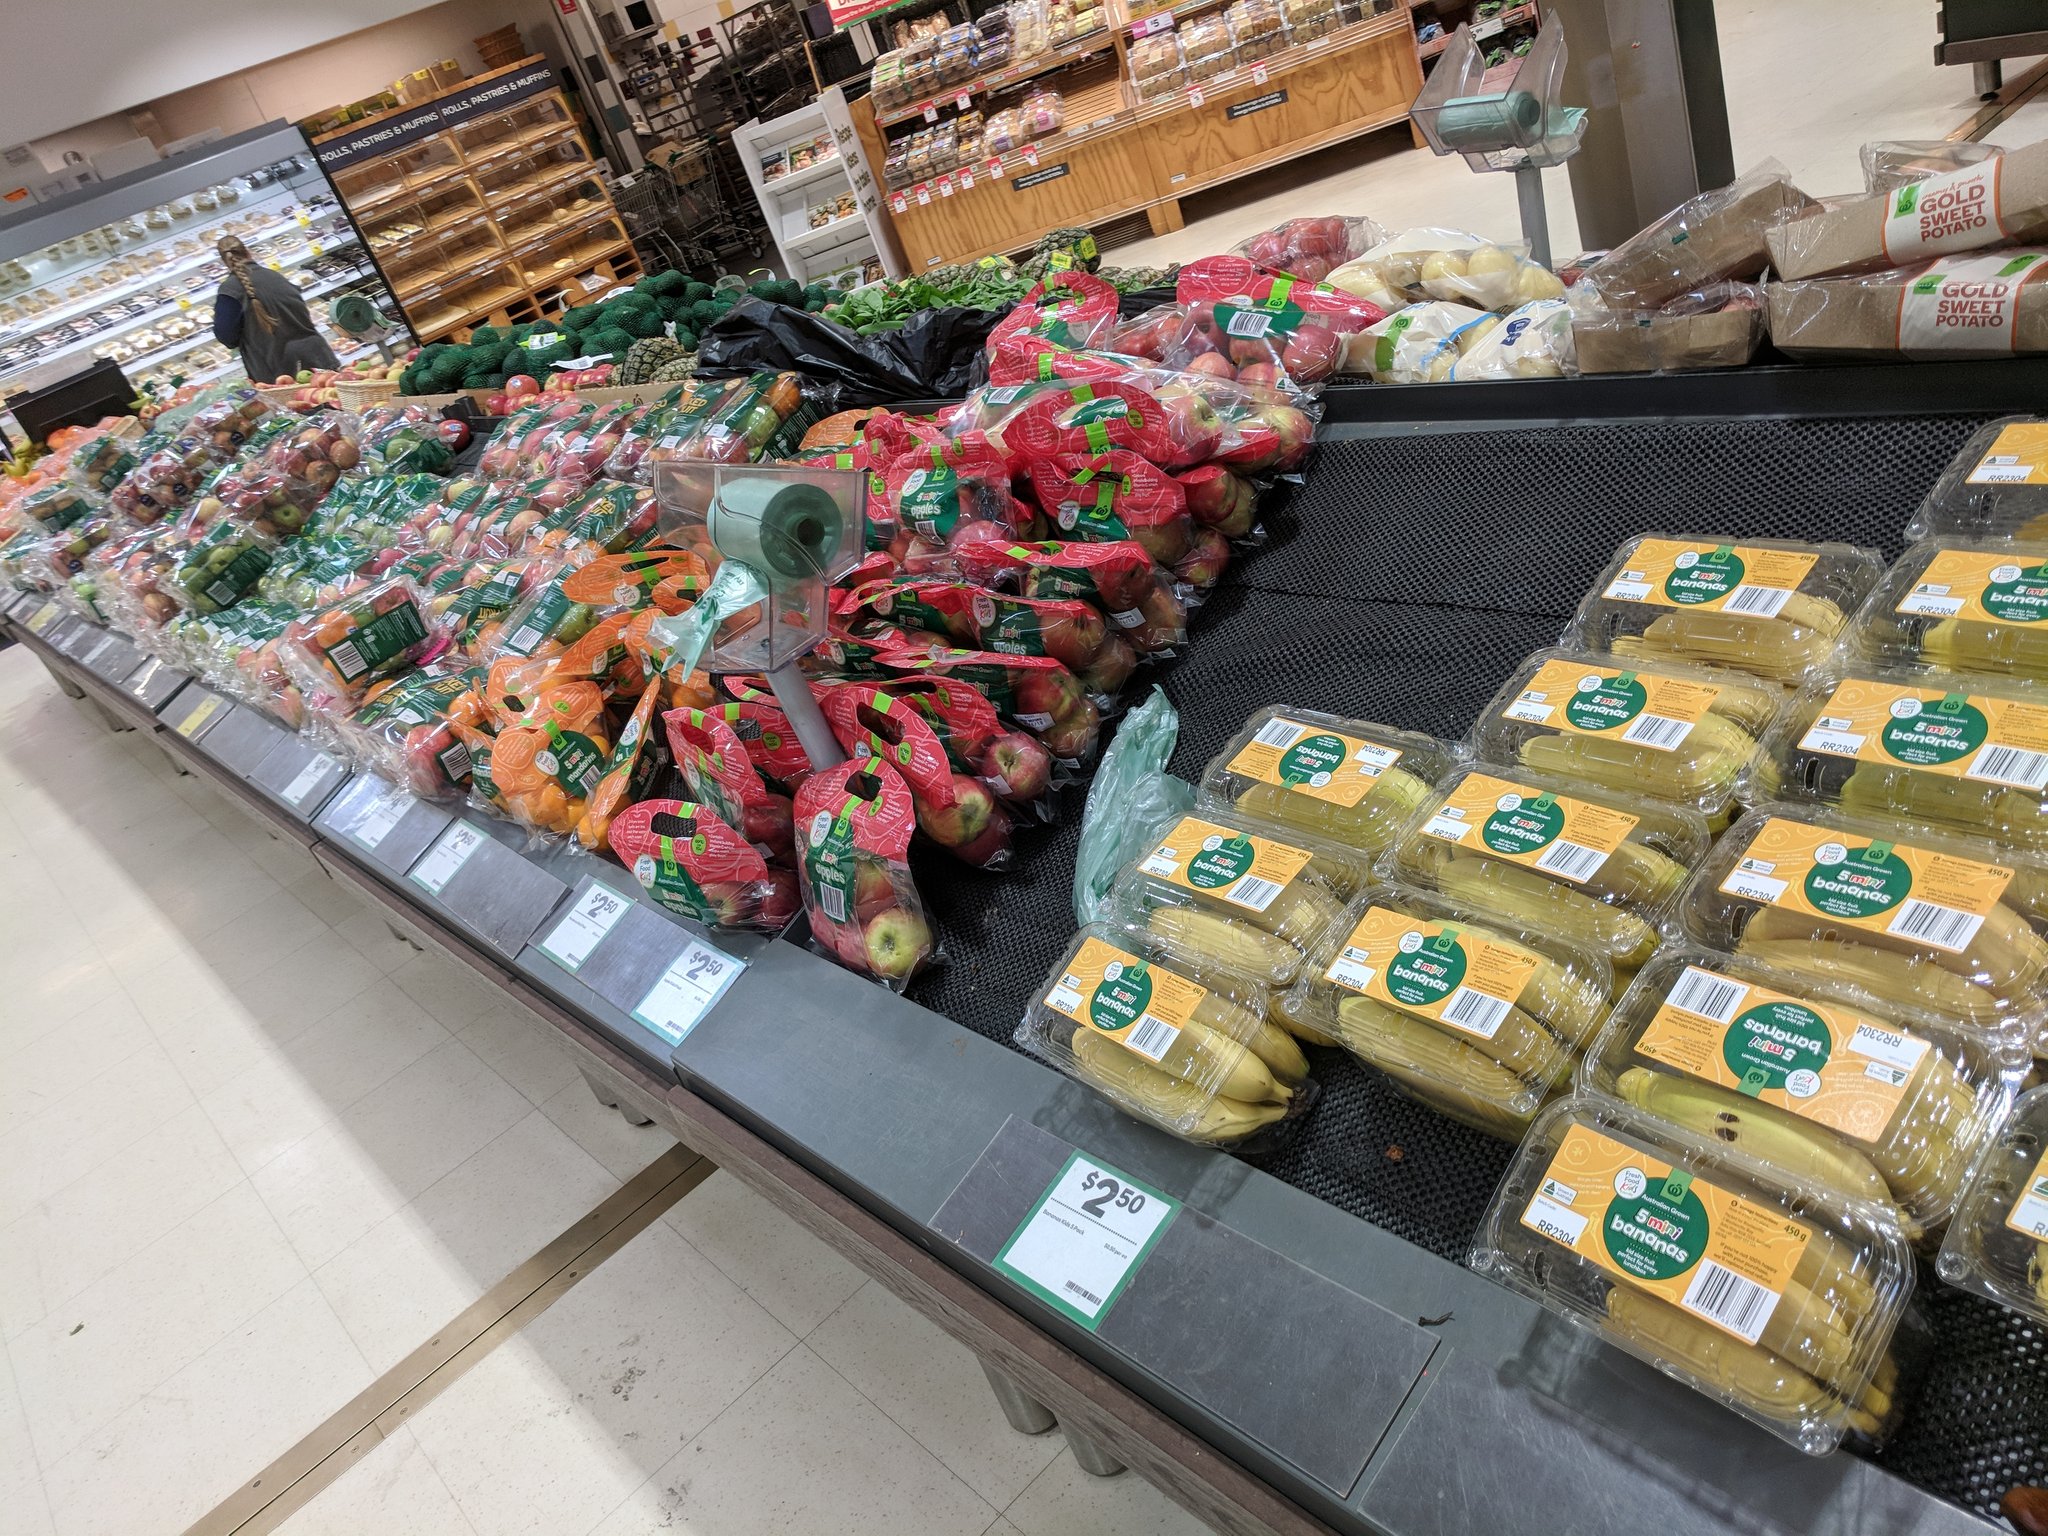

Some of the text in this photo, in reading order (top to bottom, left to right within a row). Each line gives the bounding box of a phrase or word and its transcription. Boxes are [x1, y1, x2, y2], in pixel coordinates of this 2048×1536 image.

[442, 69, 551, 116] ROLLS, PASTRIES & MUFFINS
[321, 111, 439, 163] ROLLS, PASTRIES & MUFFINS
[1920, 185, 1985, 214] GOLD
[1920, 200, 1985, 230] SWEET
[1920, 215, 1987, 242] POTATO
[1942, 282, 2008, 298] GOLD
[1938, 300, 2006, 314] SWEET
[1936, 315, 2004, 328] POTATO
[911, 502, 941, 519] apples
[1689, 570, 1725, 581] 5 mini
[1054, 580, 1062, 592] 5
[1671, 576, 1728, 592] bananas
[1917, 605, 1957, 616] RR2304
[899, 614, 906, 627] 5
[998, 625, 1005, 638] 5
[993, 641, 1027, 655] apples
[1572, 701, 1630, 719] bananas
[1591, 695, 1628, 709] 5 mini
[1515, 711, 1545, 722] RR2304
[1918, 712, 1948, 722] Australian
[1913, 721, 1962, 738] 5 mini
[1889, 729, 1969, 751] bananas
[1295, 745, 1340, 764] bananas
[1819, 741, 1859, 756] RR2304
[563, 759, 573, 770] 5
[567, 752, 597, 783] mandarins
[1315, 760, 1323, 768] 5
[1509, 815, 1545, 831] 5 mini
[1489, 820, 1545, 844] bananas
[1194, 859, 1237, 879] bananas
[1217, 856, 1237, 868] mini
[1842, 860, 1892, 875] Australian Grown
[815, 862, 845, 885] apples
[1836, 870, 1886, 889] 5 mini
[1987, 868, 2003, 876] 450
[1735, 886, 1775, 901] RR2304
[1812, 876, 1892, 905] bananas
[1439, 955, 1454, 963] Grown
[1520, 956, 1533, 965] 450
[1412, 958, 1447, 977] 5 mini
[1334, 971, 1364, 992] RR2304
[1393, 964, 1449, 992] bananas
[1111, 986, 1137, 1004] 5 mini
[1096, 992, 1137, 1018] bananas
[1743, 1018, 1823, 1056] bananas
[1857, 1025, 1903, 1048] RR2304
[1644, 1045, 1657, 1054] 450
[1749, 1036, 1797, 1062] 5 mini
[1741, 1053, 1791, 1074] Australian Grown
[1791, 1087, 1810, 1095] Fresh
[1625, 1171, 1642, 1179] Fresh
[1625, 1177, 1640, 1185] Food
[1620, 1183, 1638, 1194] Kids
[1043, 1209, 1061, 1222] Bananas
[1642, 1194, 1690, 1221] Australian Grown
[1635, 1207, 1683, 1239] 5 mini
[1536, 1219, 1575, 1246] RR2304
[1610, 1213, 1689, 1263] bananas
[1784, 1225, 1807, 1242] 450 g
[1617, 1251, 1636, 1262] perfect
[1644, 1264, 1658, 1275] every
[1623, 1259, 1646, 1275] lunchbox
[1634, 1252, 1644, 1260] size
[1644, 1257, 1655, 1266] fruit
